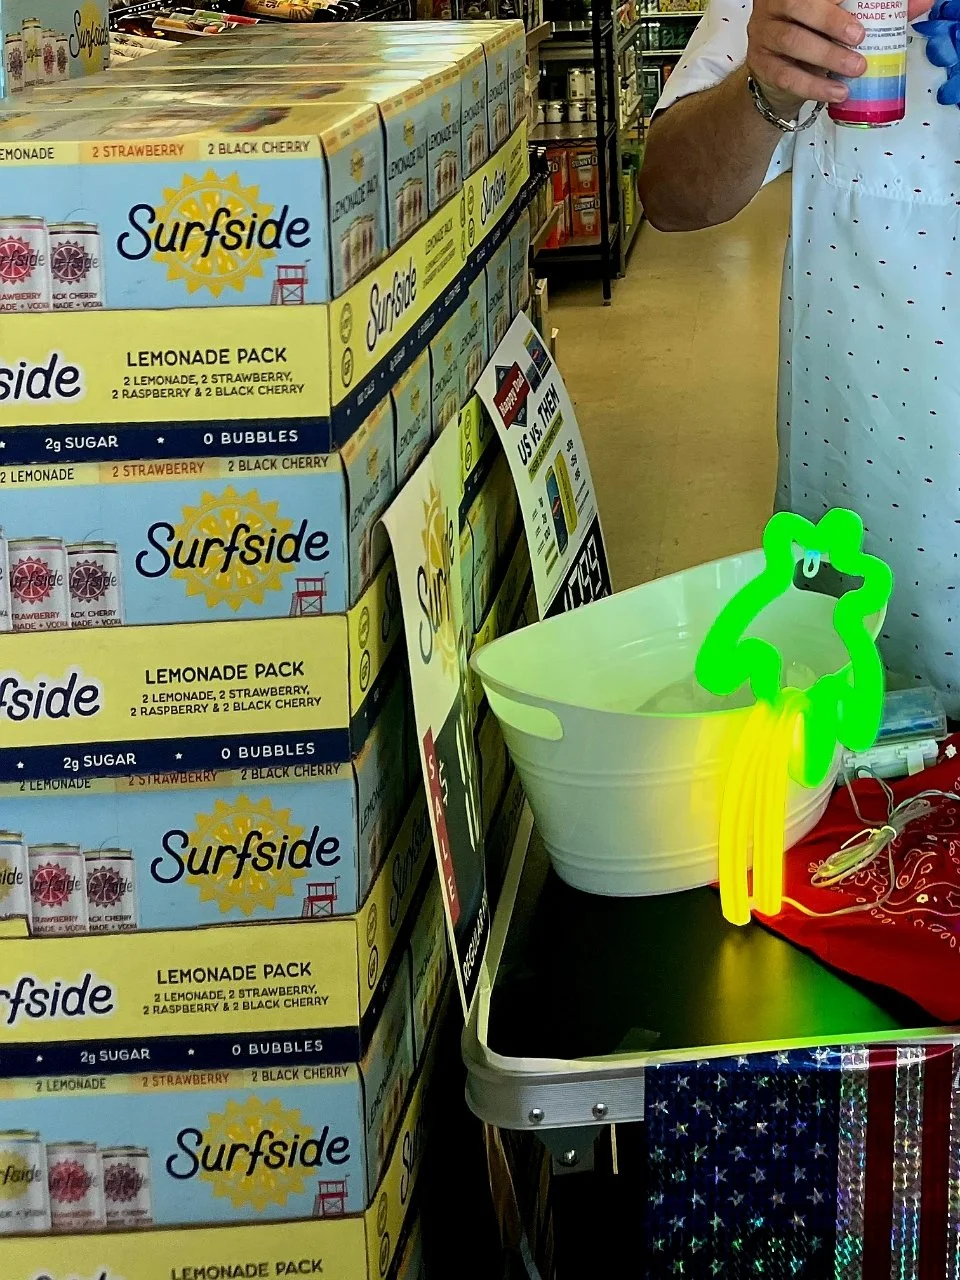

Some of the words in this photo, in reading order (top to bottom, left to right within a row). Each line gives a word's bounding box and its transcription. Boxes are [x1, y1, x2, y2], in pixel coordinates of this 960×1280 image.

[857, 1, 903, 10] RASPBERRY
[0, 147, 55, 160] EMONADE
[92, 146, 100, 158] 2
[103, 144, 184, 158] STRAWBERRY
[208, 143, 215, 155] 2
[218, 142, 258, 155] BLACK
[262, 140, 311, 153] CHERRY
[117, 203, 312, 260] Surfside
[127, 349, 230, 367] LEMONADE
[237, 347, 287, 365] PACK
[0, 353, 81, 401] side
[124, 376, 131, 386] 2
[133, 375, 198, 387] LEMONADE,
[201, 375, 208, 384] 2
[211, 372, 293, 384] STRAWBERRY,
[112, 390, 119, 399] 2
[122, 388, 190, 400] RASPBERRY
[195, 387, 202, 398] &
[205, 387, 212, 397] 2
[215, 385, 255, 397] BLACK
[258, 384, 304, 395] CHERRY
[517, 434, 532, 466] US
[537, 383, 560, 426] THEM
[45, 437, 62, 452] 2g
[65, 435, 119, 449] SUGAR
[203, 433, 214, 445] 0
[221, 430, 298, 445] BUBBLES
[10, 469, 75, 483] LEMONADE
[112, 466, 119, 478] 2
[123, 462, 205, 477] STRAWBERRY
[228, 460, 235, 472] 2
[238, 458, 278, 471] BLACK
[281, 456, 329, 469] CHERRY
[135, 519, 330, 578] Surfside
[145, 664, 248, 685] LEMONADE
[255, 661, 305, 679] PACK
[0, 673, 100, 721] fside
[221, 747, 231, 760] 0
[238, 742, 316, 758] BUBBLES
[63, 757, 79, 771] 2g
[83, 753, 137, 768] SUGAR
[150, 825, 341, 884] Surfside
[157, 965, 257, 985] LEMONADE
[263, 961, 312, 980] PACK
[0, 973, 114, 1024] fside
[80, 1050, 96, 1065] 2g
[99, 1047, 151, 1063] SUGAR
[232, 1044, 241, 1056] 0
[249, 1039, 323, 1055] BUBBLES
[166, 1126, 350, 1180] Surfside
[172, 1262, 269, 1280] LEMONADE
[275, 1259, 323, 1276] PACK
